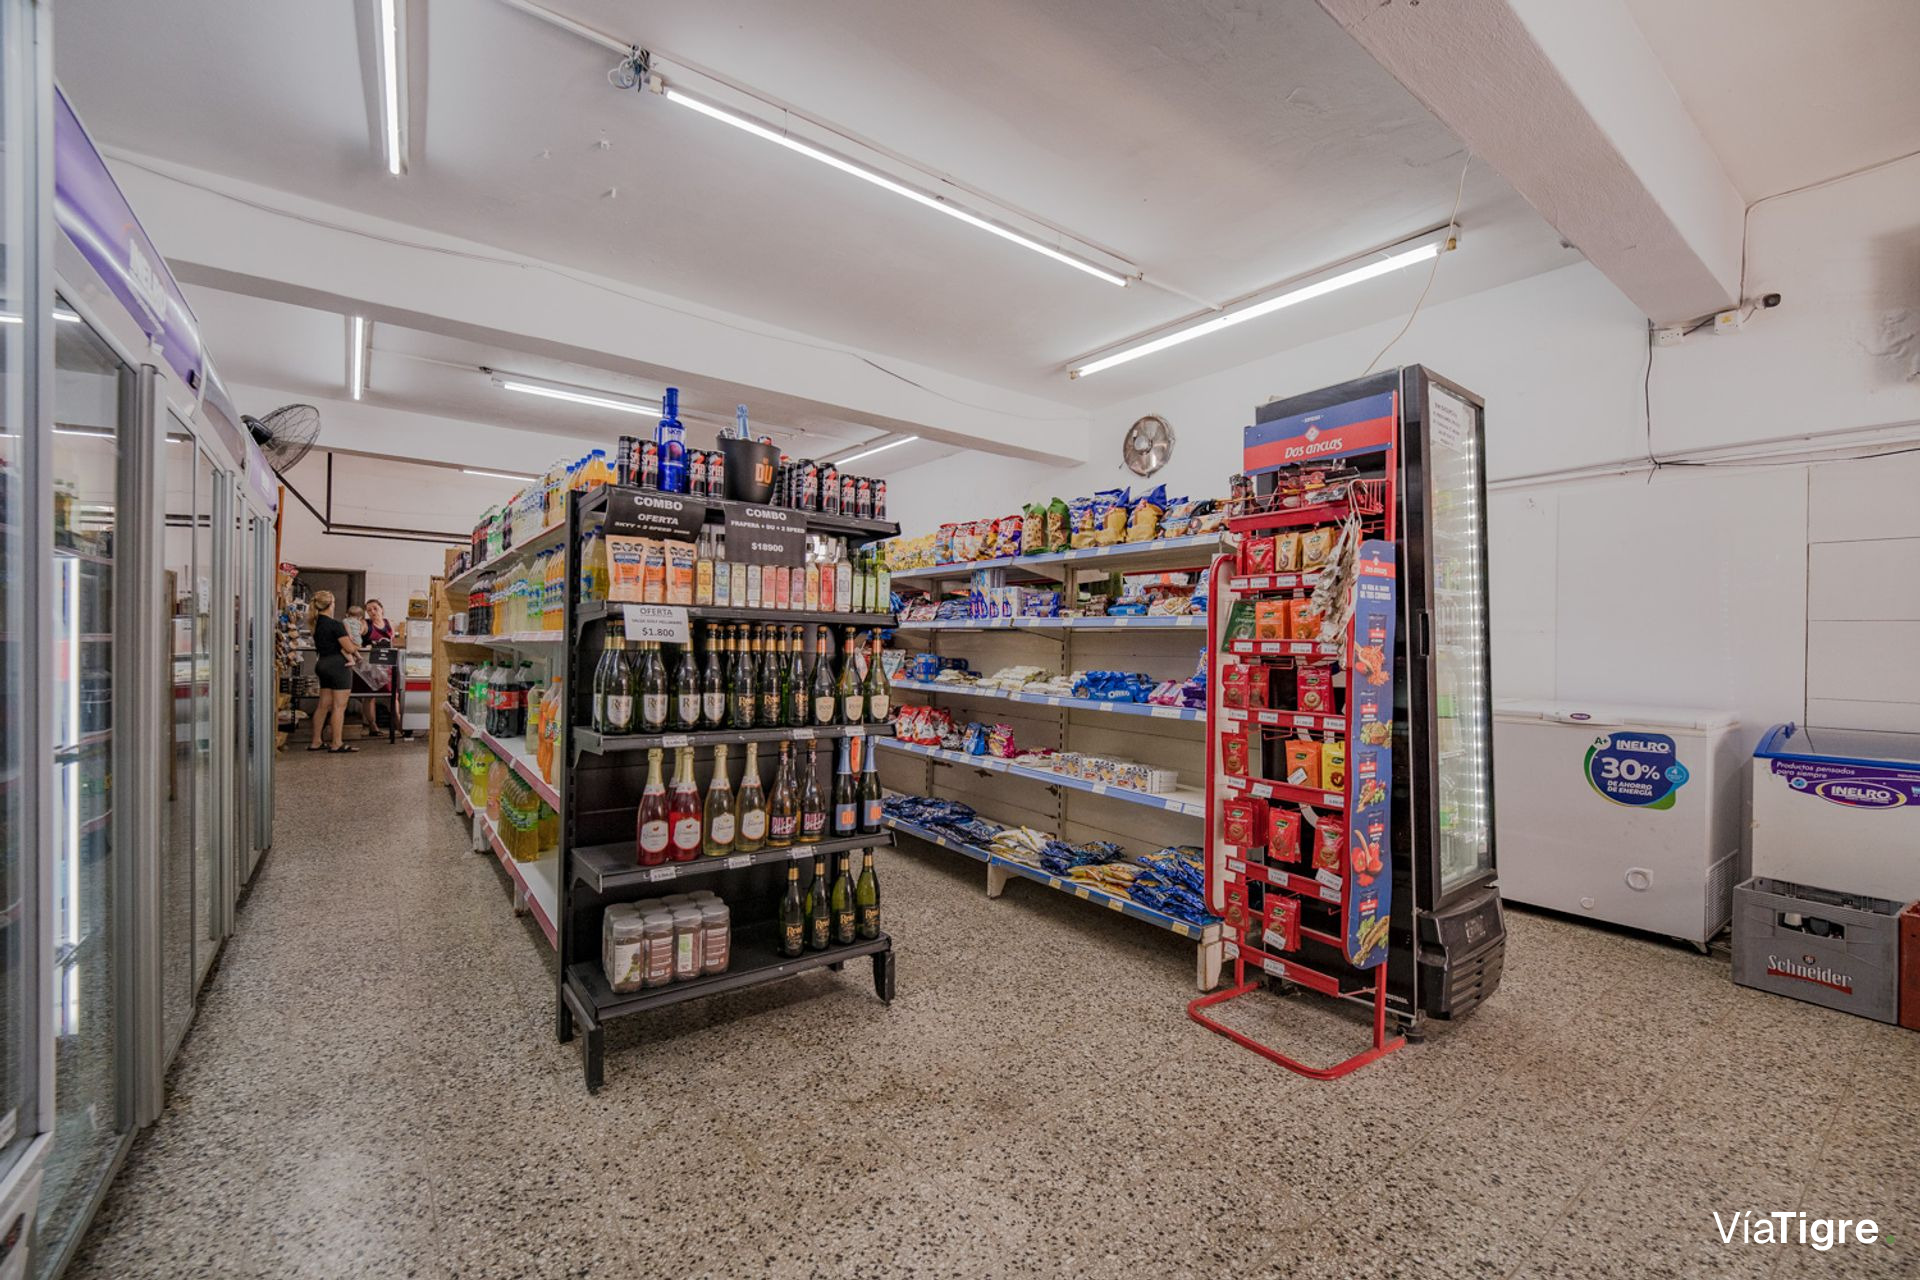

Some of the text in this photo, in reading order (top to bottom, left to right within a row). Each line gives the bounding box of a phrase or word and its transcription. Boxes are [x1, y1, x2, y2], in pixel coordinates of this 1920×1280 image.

[1285, 438, 1343, 459] Dos anclas
[634, 496, 683, 511] COMBO
[638, 513, 679, 525] OFERTA
[746, 508, 787, 521] COMBO
[751, 542, 784, 552] $18900
[640, 608, 673, 616] OFERTA
[642, 628, 675, 637] $1.800
[1594, 736, 1609, 745] A+
[1616, 740, 1670, 754] INELRO
[1601, 757, 1661, 780] 30%
[1776, 762, 1855, 775] Productos pensados
[1797, 770, 1827, 779] siempre
[1618, 781, 1653, 790] AHORRO
[1831, 786, 1890, 800] INELRO
[1767, 955, 1852, 987] Schneider
